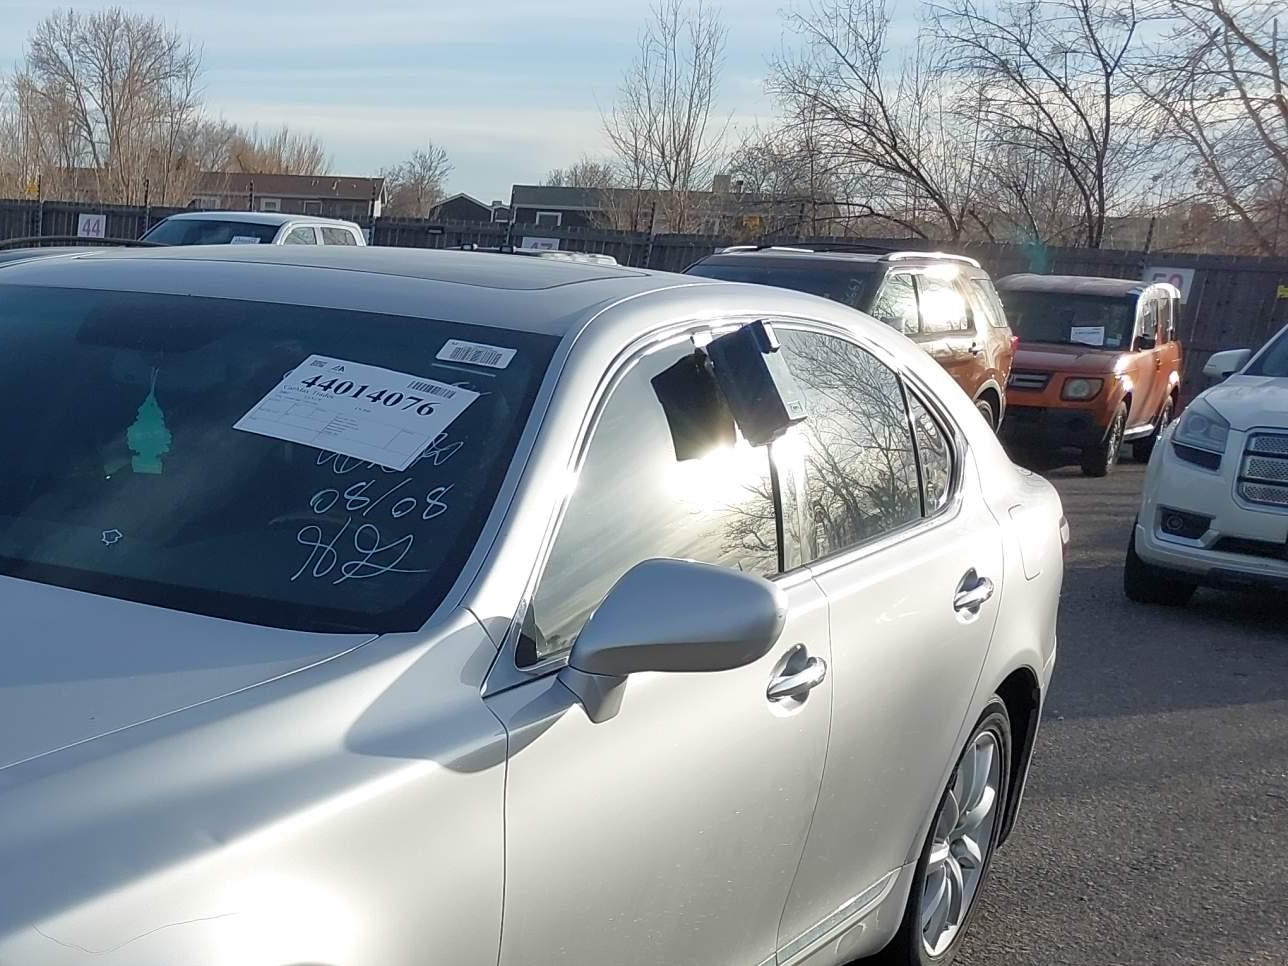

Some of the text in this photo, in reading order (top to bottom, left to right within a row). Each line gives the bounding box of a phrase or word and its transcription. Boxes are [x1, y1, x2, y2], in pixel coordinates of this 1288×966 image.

[82, 218, 101, 236] 44
[301, 374, 441, 416] 44014076
[310, 477, 455, 520] 08/08
